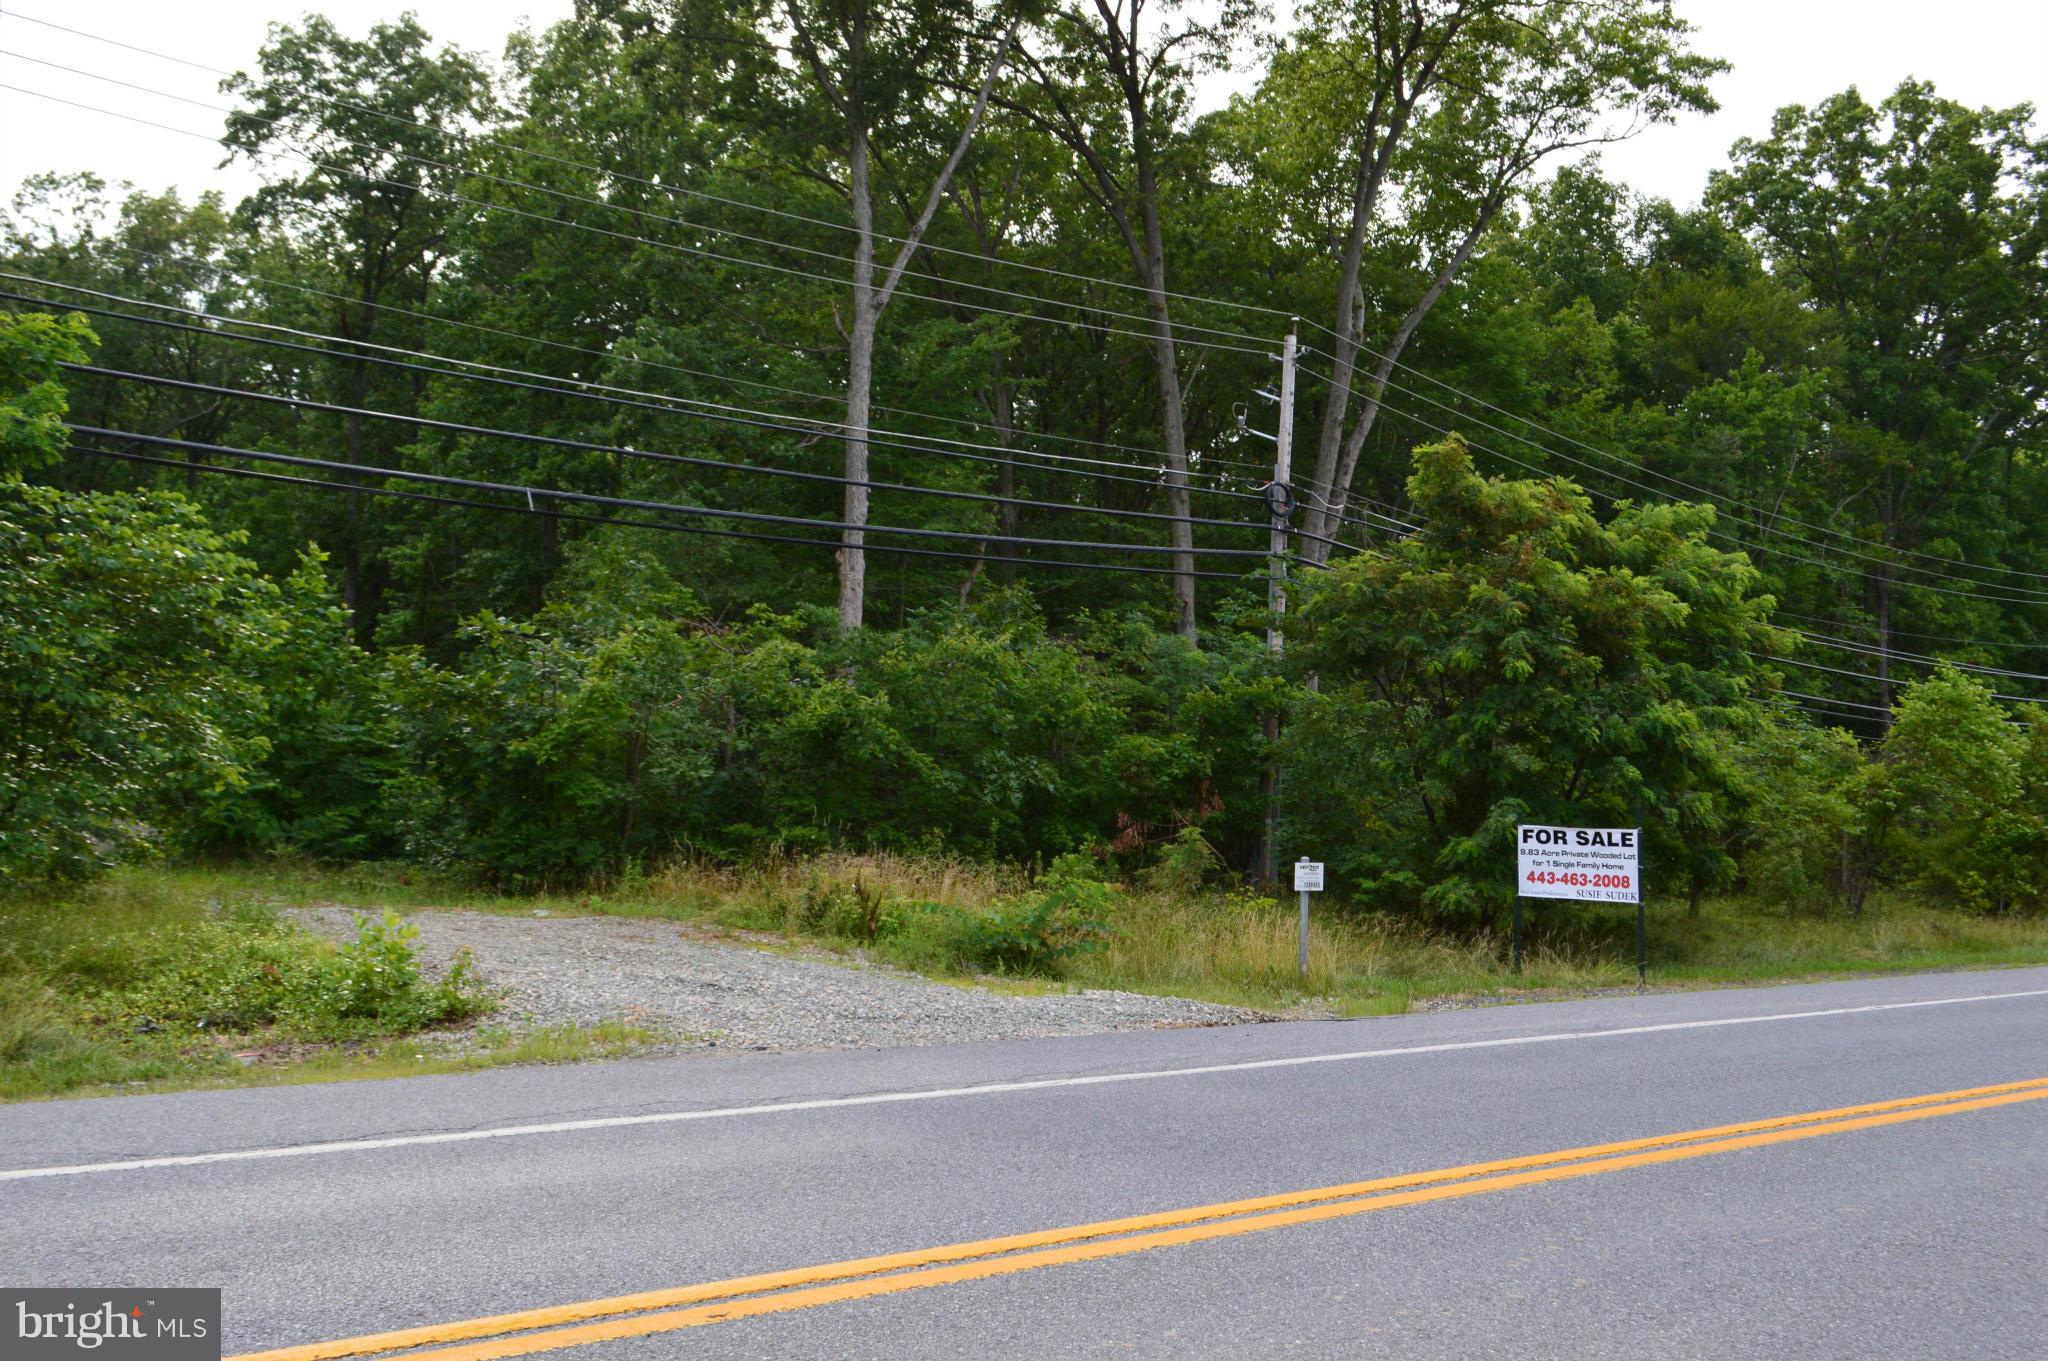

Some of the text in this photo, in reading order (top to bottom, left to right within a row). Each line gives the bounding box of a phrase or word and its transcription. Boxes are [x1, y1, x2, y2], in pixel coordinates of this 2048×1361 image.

[1522, 829, 1634, 848] FOR SALE
[1520, 848, 1636, 860] 9.83 Acre Private Wooded Lot
[1532, 859, 1624, 871] for 1 Single Family Home
[1527, 871, 1630, 888] 443-463-2008
[1576, 889, 1602, 900] SUSIE
[1605, 891, 1637, 901] SUDEK
